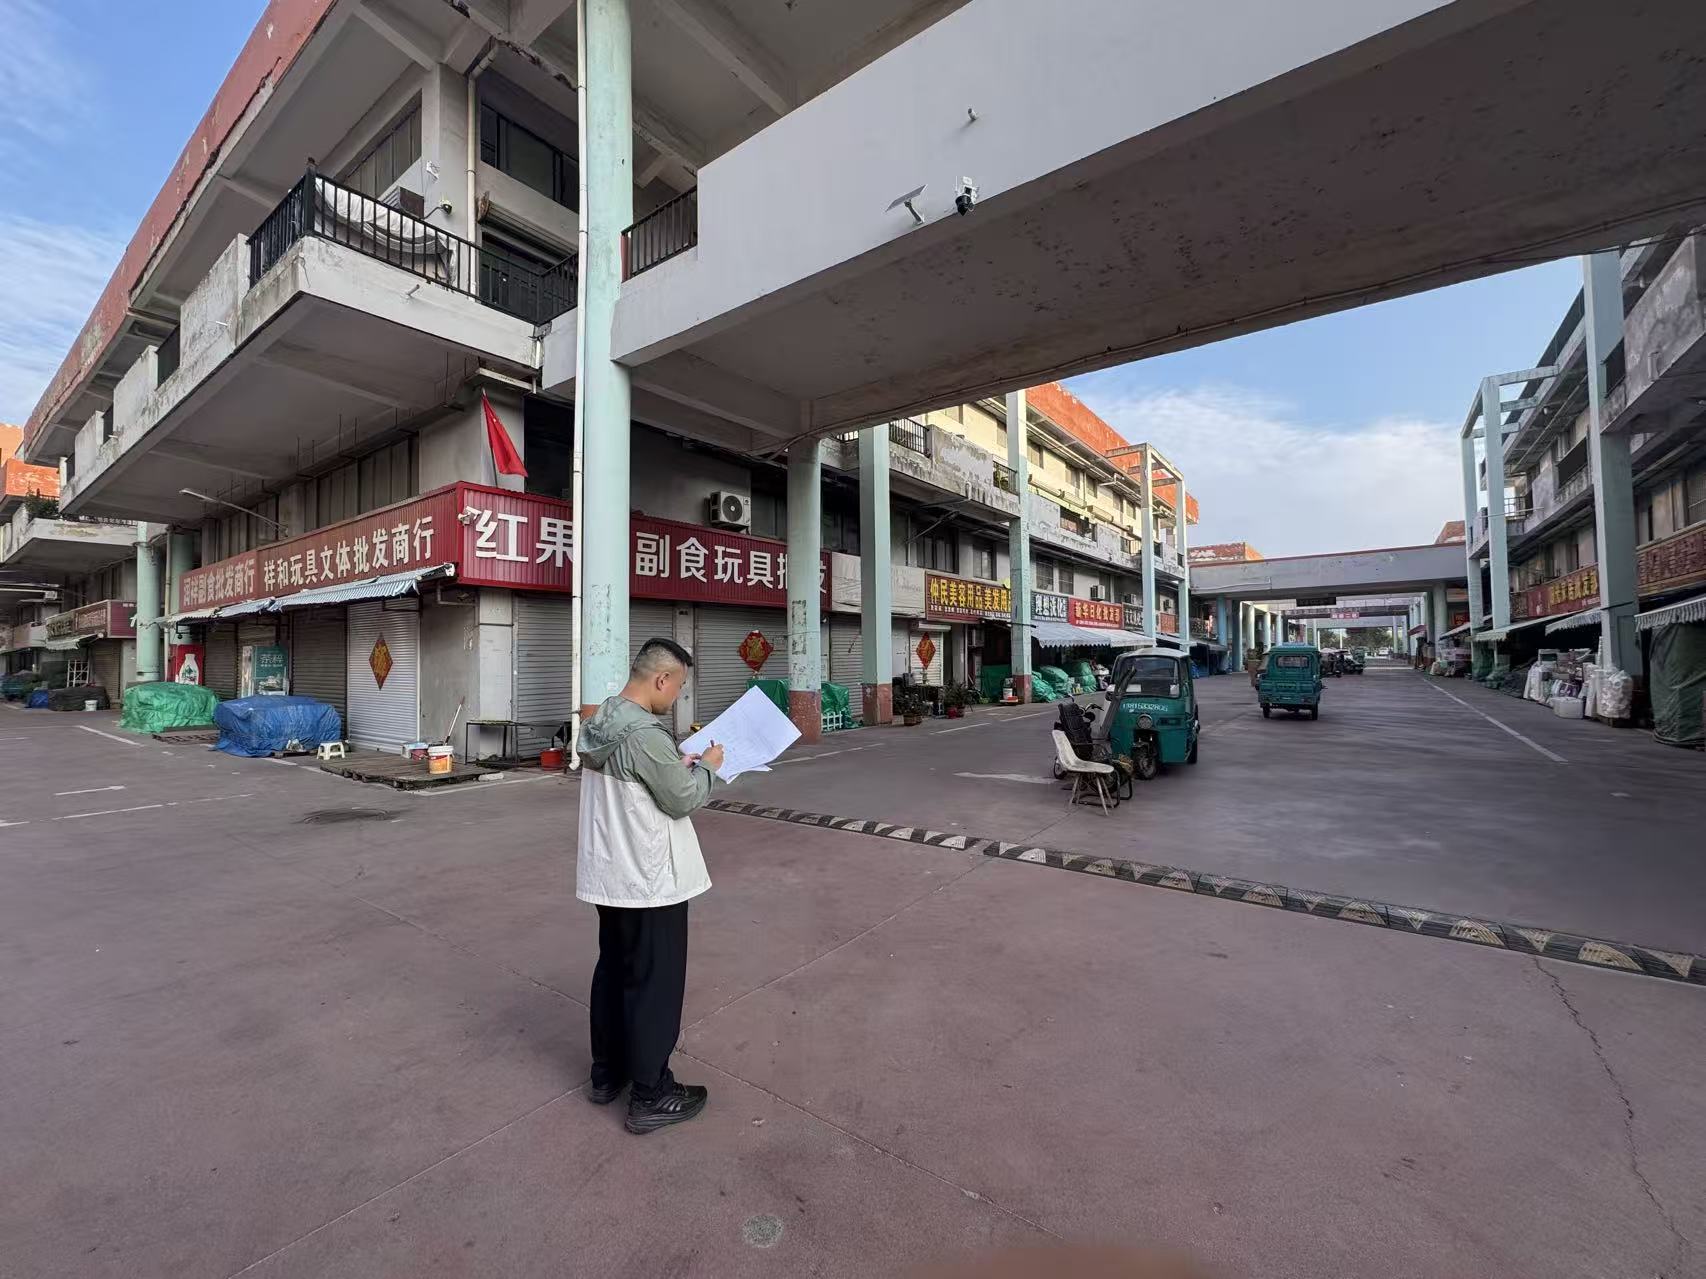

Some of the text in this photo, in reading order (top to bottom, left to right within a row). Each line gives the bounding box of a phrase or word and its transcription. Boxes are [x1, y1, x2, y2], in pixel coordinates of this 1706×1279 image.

[263, 515, 435, 592] 祥和玩具文体批发商行
[929, 578, 1011, 612] 仲民美容用品美发用
